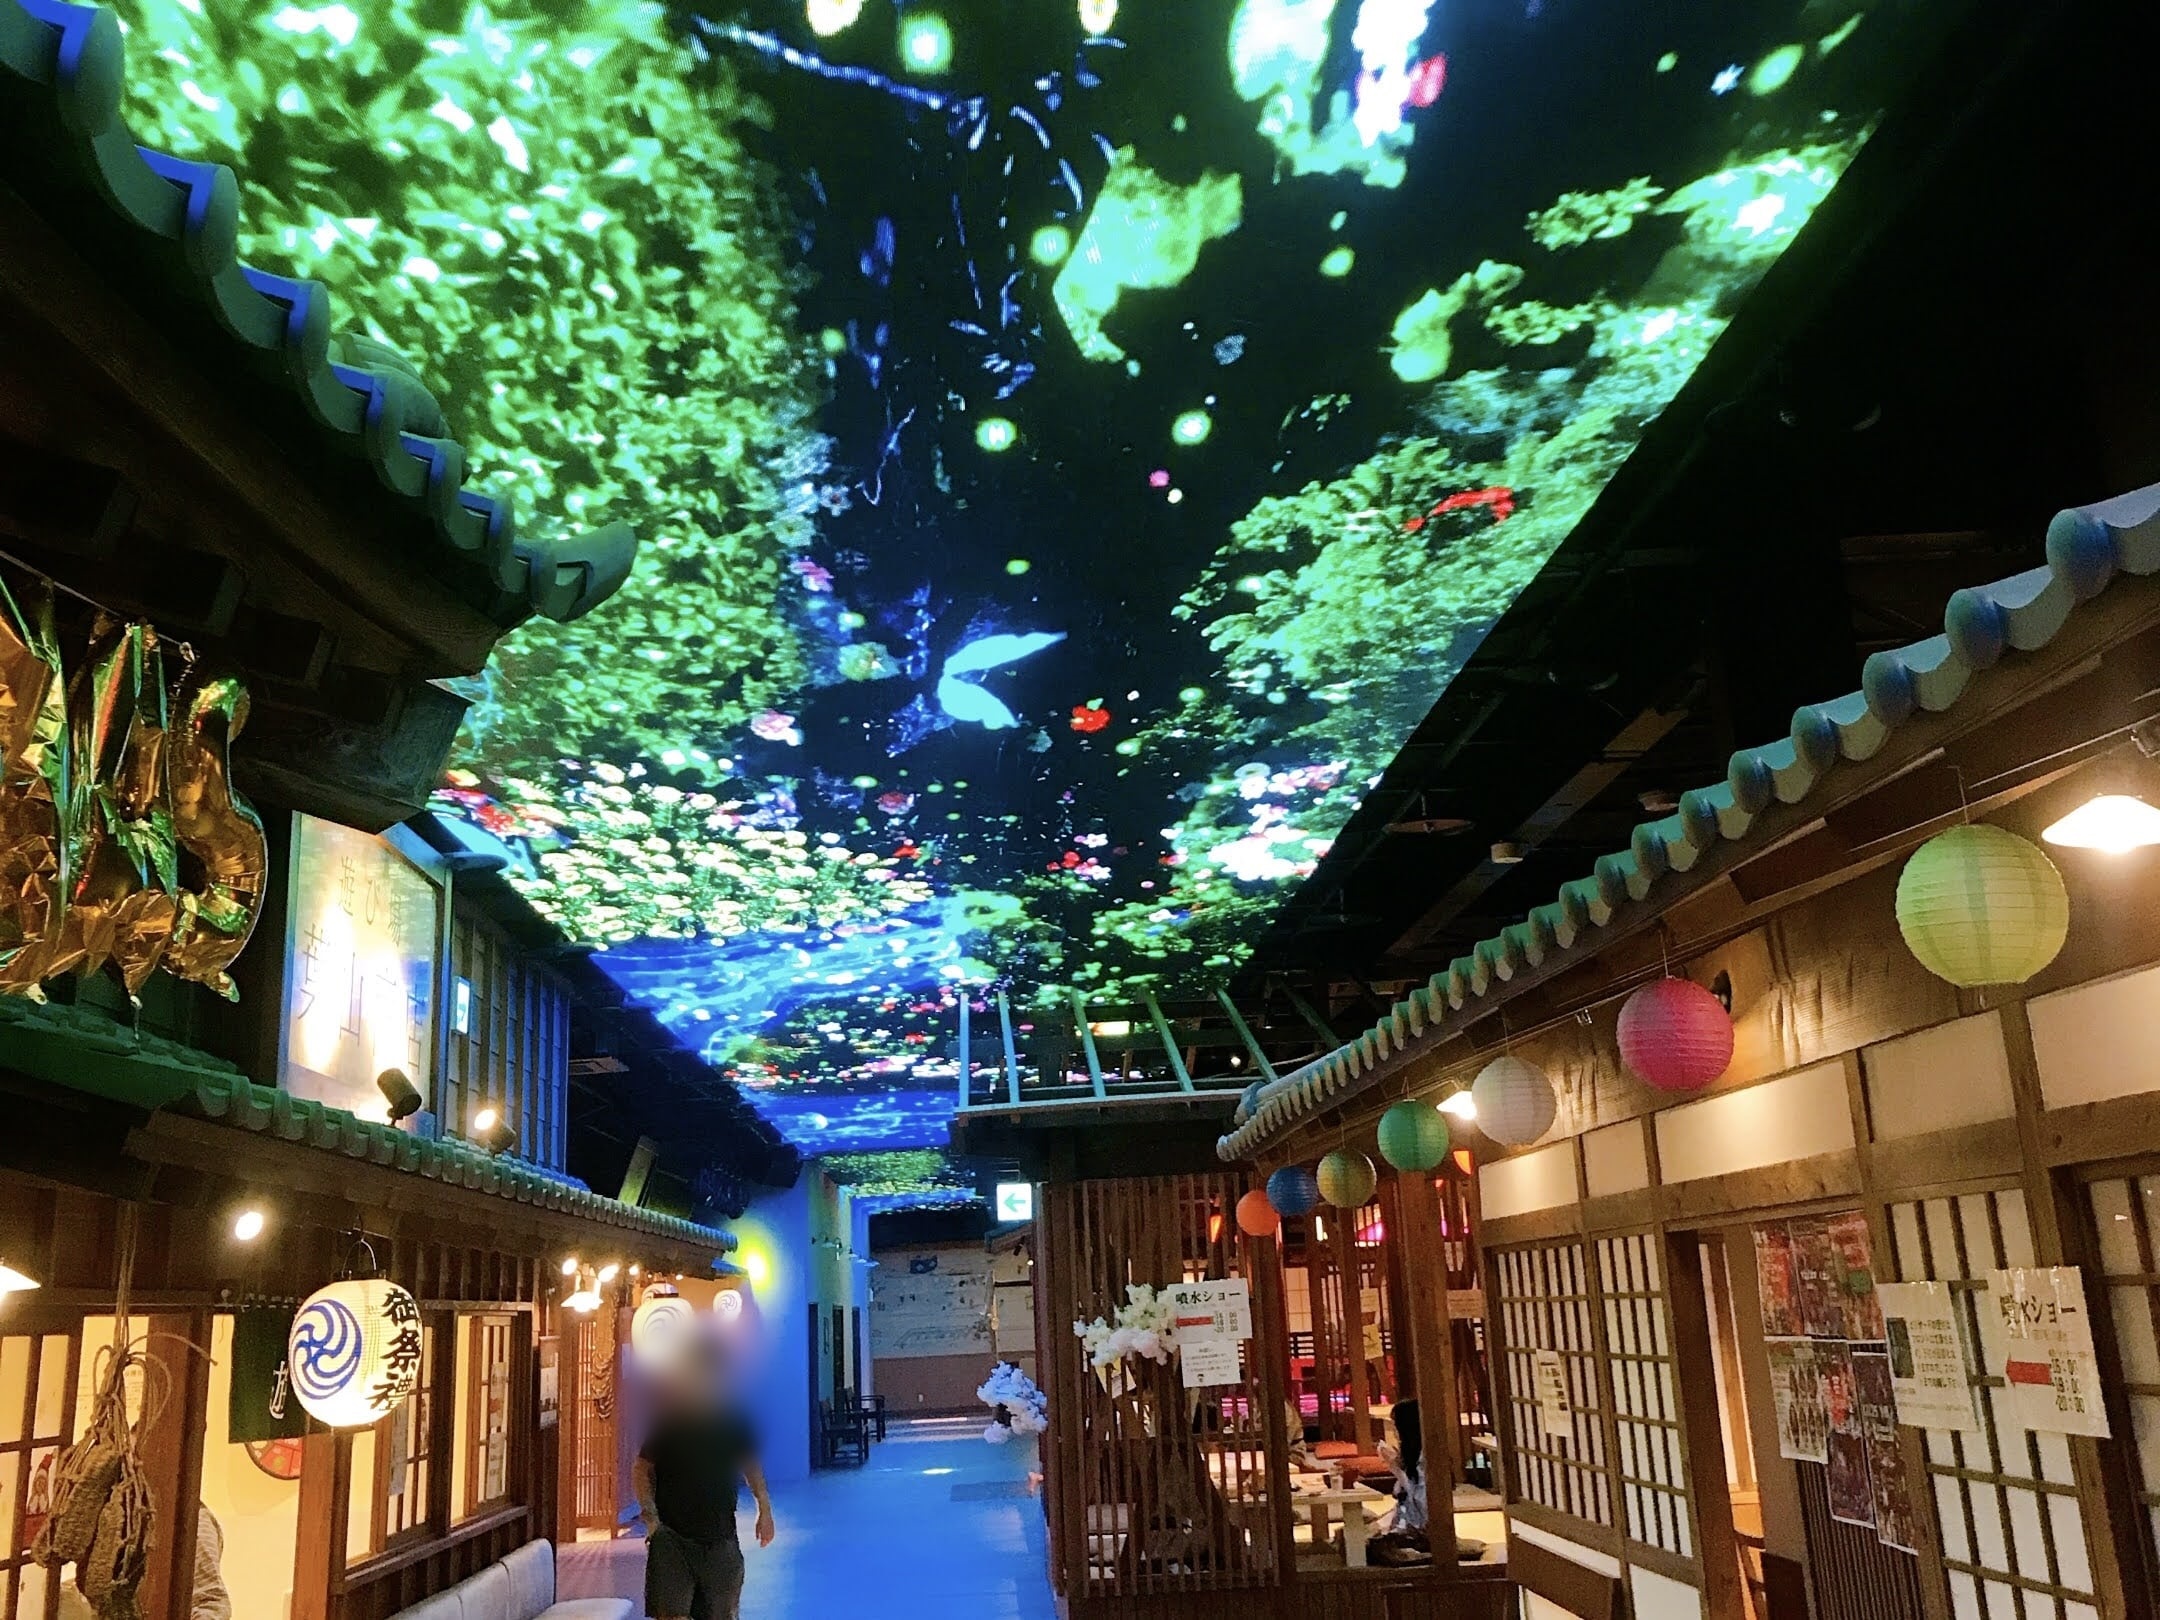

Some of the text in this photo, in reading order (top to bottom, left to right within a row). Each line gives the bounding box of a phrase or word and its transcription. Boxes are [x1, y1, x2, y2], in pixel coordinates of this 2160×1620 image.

[1175, 1290, 1242, 1305] 噴水ショー
